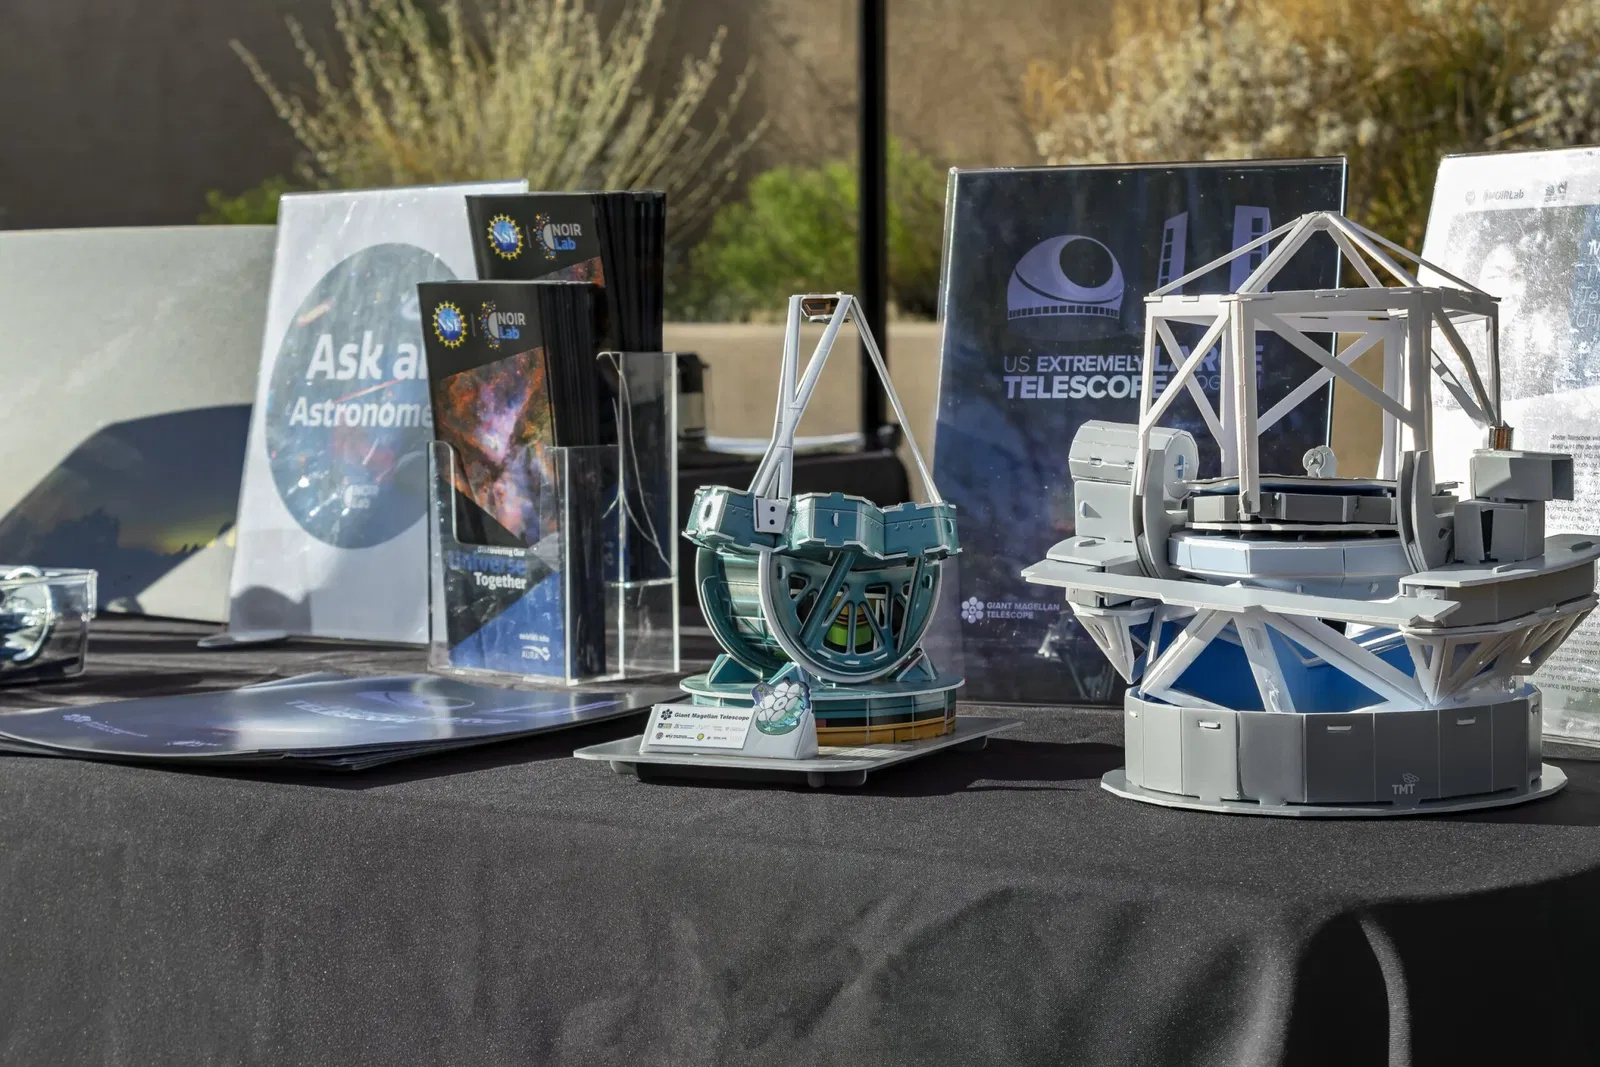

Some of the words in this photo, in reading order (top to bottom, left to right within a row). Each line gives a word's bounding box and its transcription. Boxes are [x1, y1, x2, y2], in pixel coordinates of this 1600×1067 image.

[552, 223, 582, 236] NOIR
[554, 236, 576, 250] Lab
[497, 312, 526, 325] NOIR
[499, 325, 520, 339] Lab
[305, 330, 384, 380] Ask
[1003, 355, 1030, 373] US
[1036, 355, 1144, 373] EXTREMELY
[1153, 345, 1264, 373] LRE
[1003, 375, 1168, 400] TELESCOPE
[288, 396, 434, 428] Astronome
[449, 550, 527, 575] Universe
[474, 572, 527, 590] Together
[986, 601, 1012, 610] GIANT
[1014, 603, 1060, 612] MAGELLAN
[1391, 784, 1415, 795] TMT
